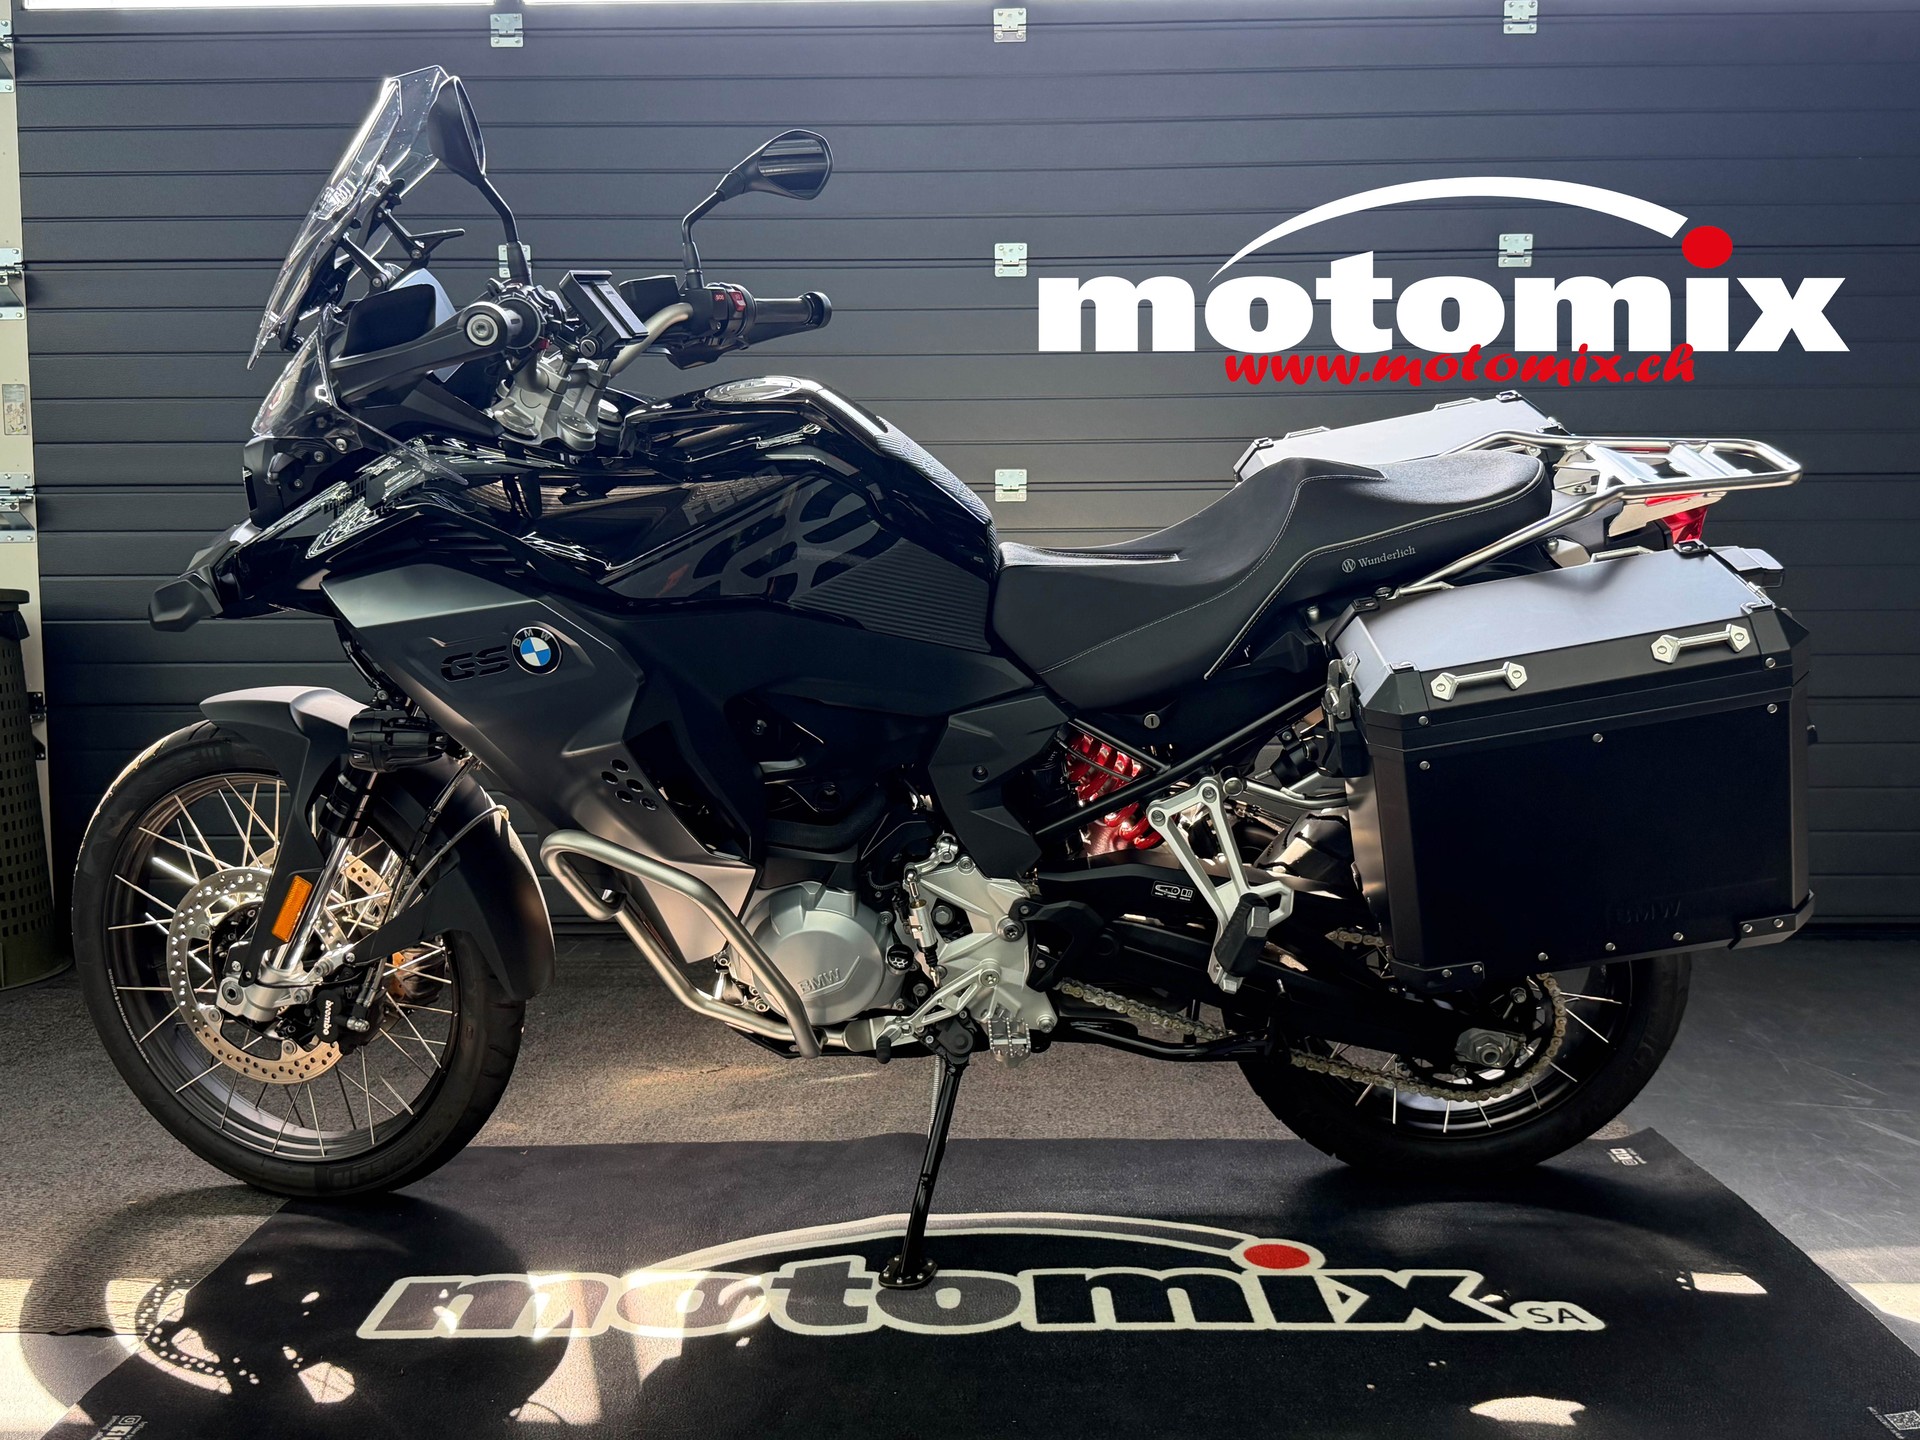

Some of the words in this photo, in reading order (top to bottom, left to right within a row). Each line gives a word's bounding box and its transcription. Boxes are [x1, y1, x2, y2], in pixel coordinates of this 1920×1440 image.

[1358, 545, 1416, 568] Wunderlich
[512, 628, 551, 648] BMW
[440, 645, 511, 682] GS
[798, 967, 841, 995] BMW
[322, 999, 335, 1036] brembo
[362, 1239, 1515, 1333] motomix
[1526, 1307, 1588, 1325] SA
